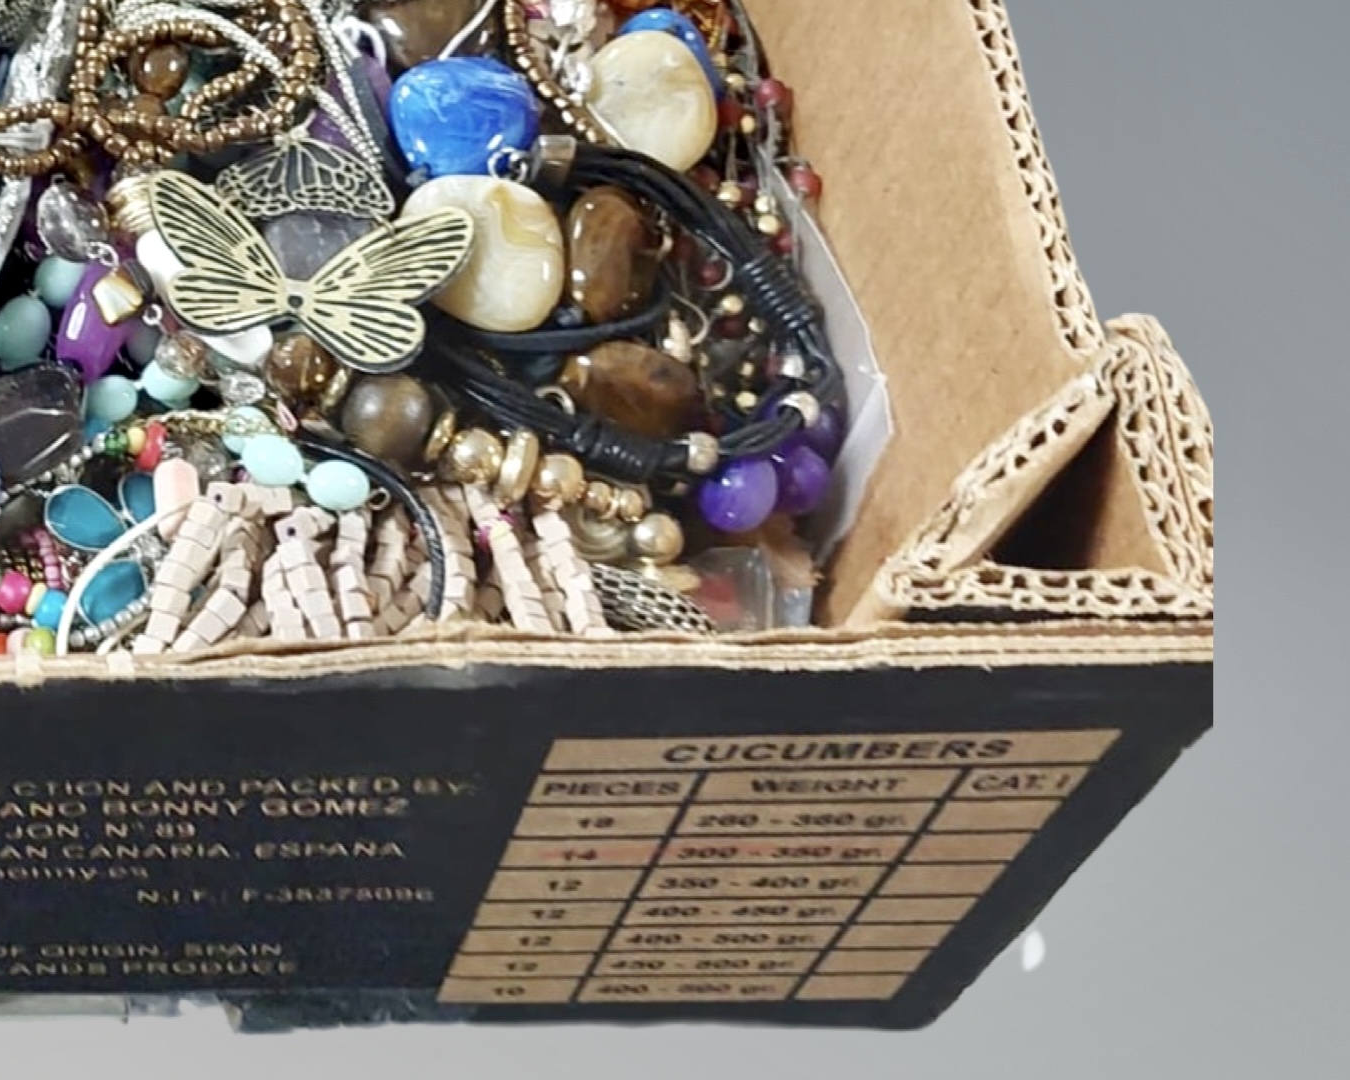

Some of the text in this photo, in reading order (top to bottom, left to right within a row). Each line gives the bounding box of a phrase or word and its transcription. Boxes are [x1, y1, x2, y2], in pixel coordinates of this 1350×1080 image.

[662, 738, 1015, 765] CUCUMBERS
[143, 779, 226, 798] AND
[240, 776, 400, 796] PACKED
[541, 778, 682, 797] PIECES
[749, 776, 906, 795] WEIGHT
[103, 797, 249, 818] BONNY
[184, 941, 283, 957] SPAIN
[122, 959, 297, 976] PRODUCE
